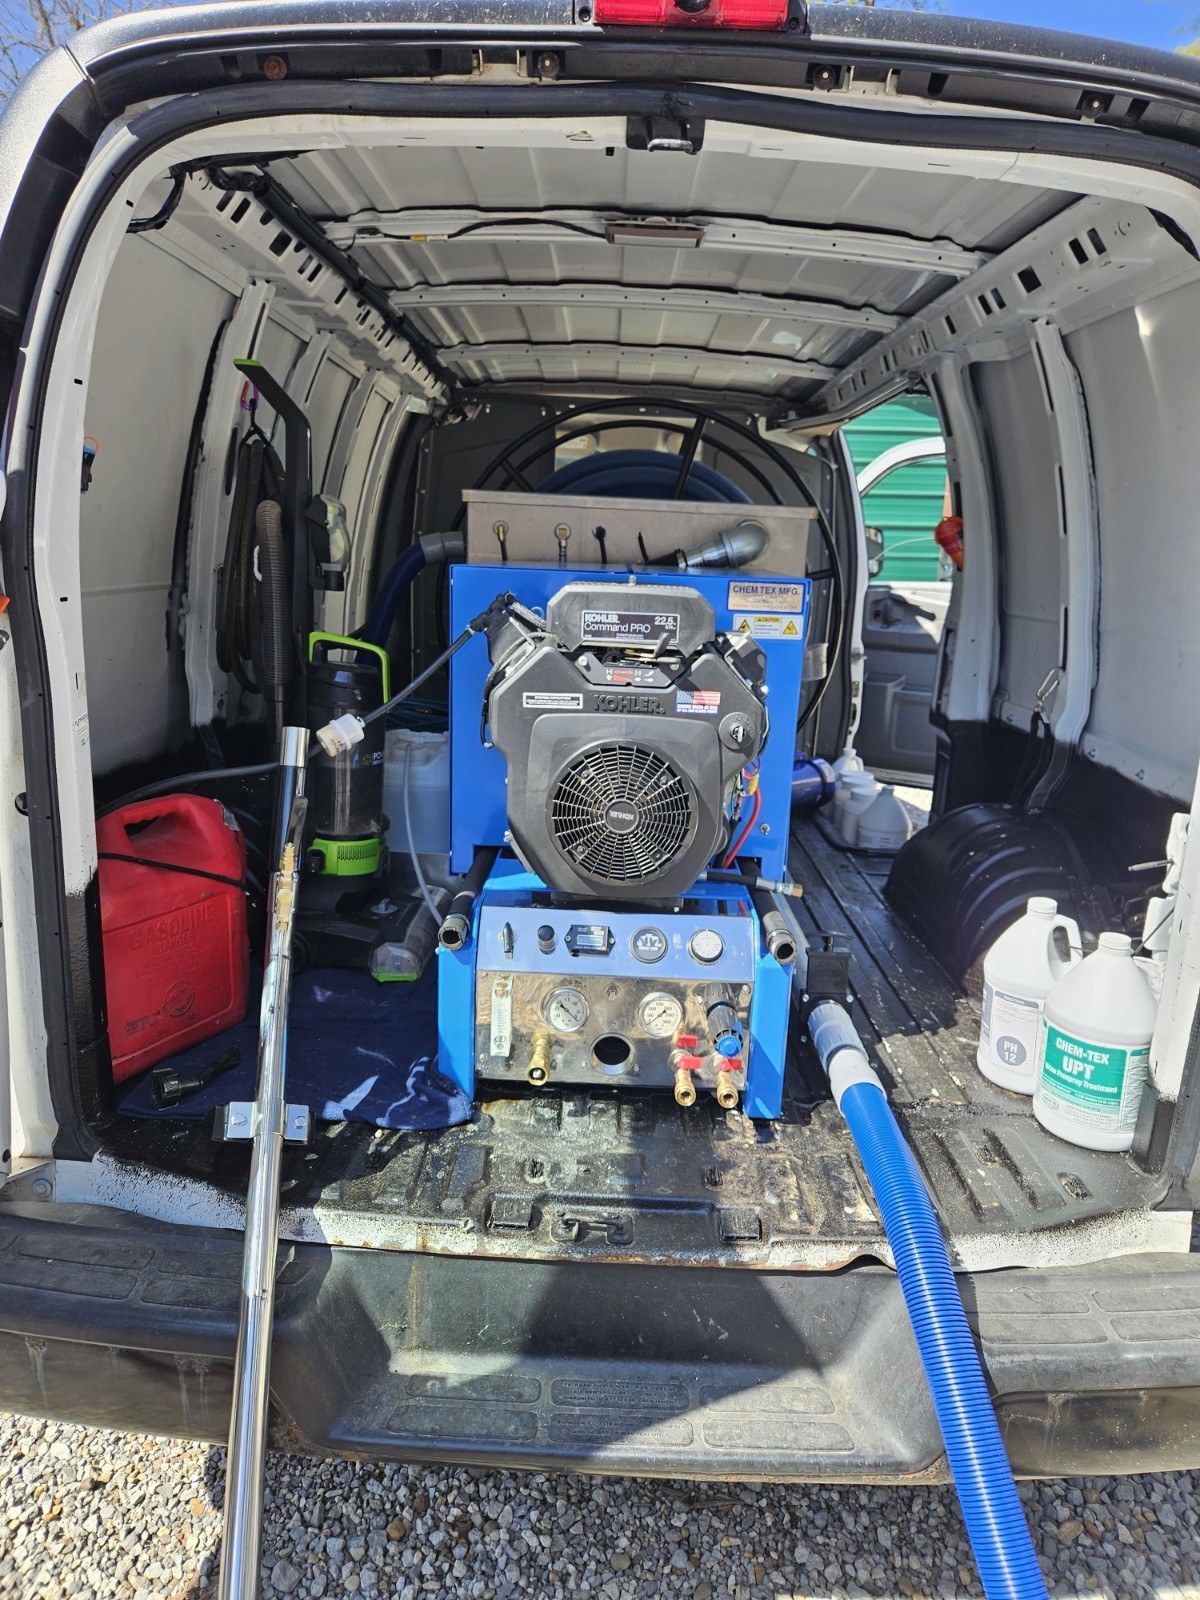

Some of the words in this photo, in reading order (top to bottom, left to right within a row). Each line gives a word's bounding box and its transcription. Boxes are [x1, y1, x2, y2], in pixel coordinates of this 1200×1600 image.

[733, 585, 758, 593] CHEM
[760, 586, 776, 595] TEX
[779, 587, 800, 596] MFG.
[584, 622, 629, 632] Command
[630, 623, 651, 633] PRO
[128, 904, 214, 951] GASOLINE
[1003, 1041, 1018, 1054] PH
[1055, 1037, 1110, 1065] CHEM-TEX
[1003, 1052, 1017, 1063] 12
[1062, 1056, 1095, 1080] UPT
[1056, 1069, 1083, 1088] Prespray
[1083, 1080, 1118, 1094] Treatment
